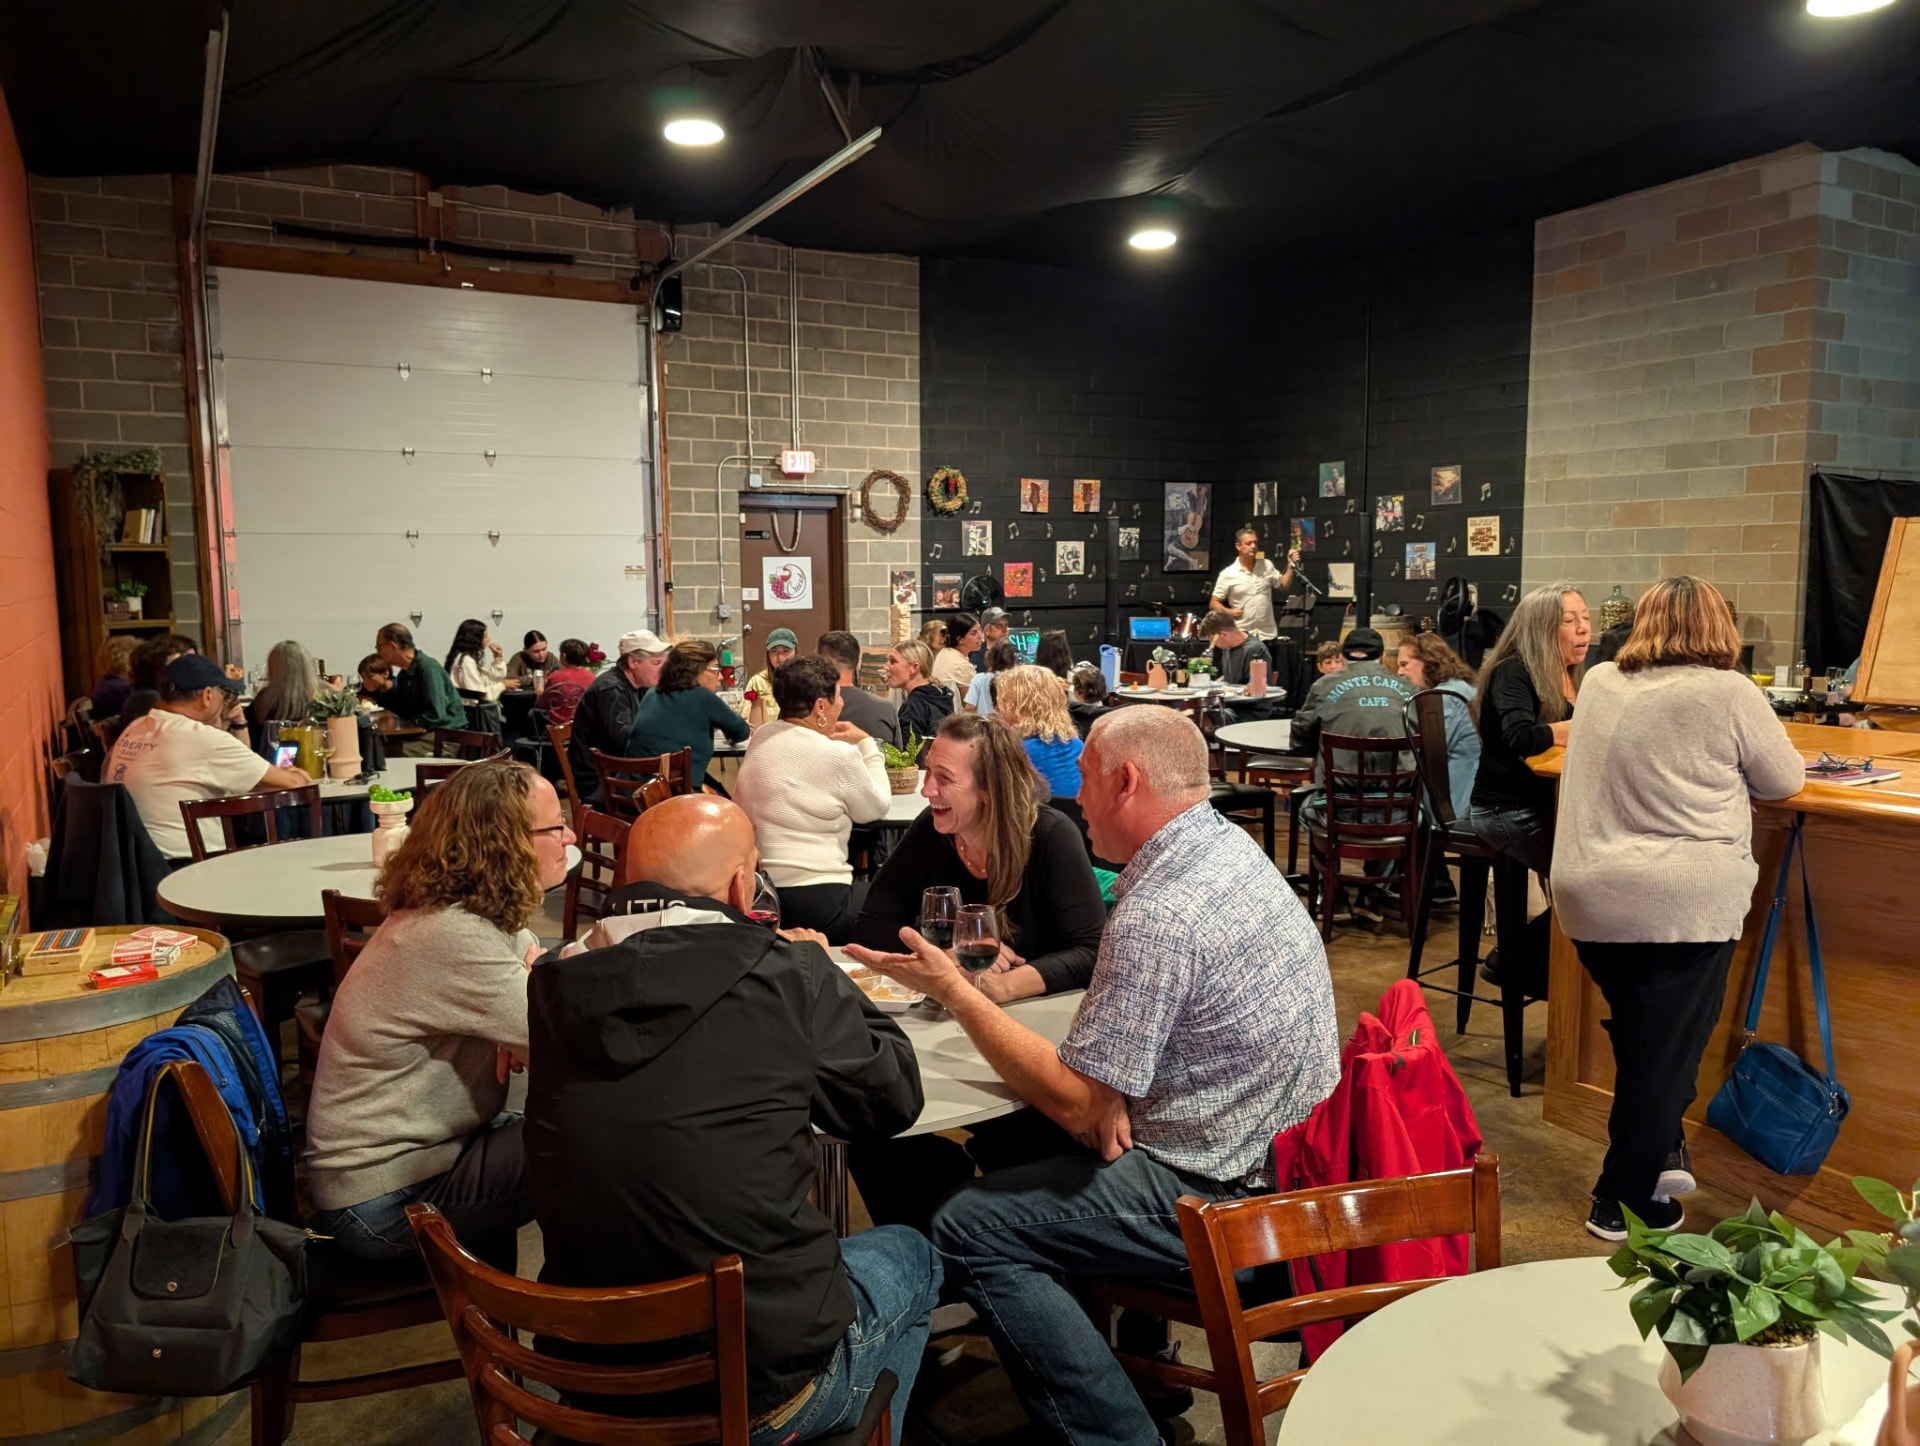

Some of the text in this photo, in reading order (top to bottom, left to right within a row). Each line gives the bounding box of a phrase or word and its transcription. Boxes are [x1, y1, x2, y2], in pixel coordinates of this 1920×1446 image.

[787, 452, 810, 472] EXIT
[1326, 675, 1372, 703] MONTE
[1358, 696, 1389, 707] CAFE
